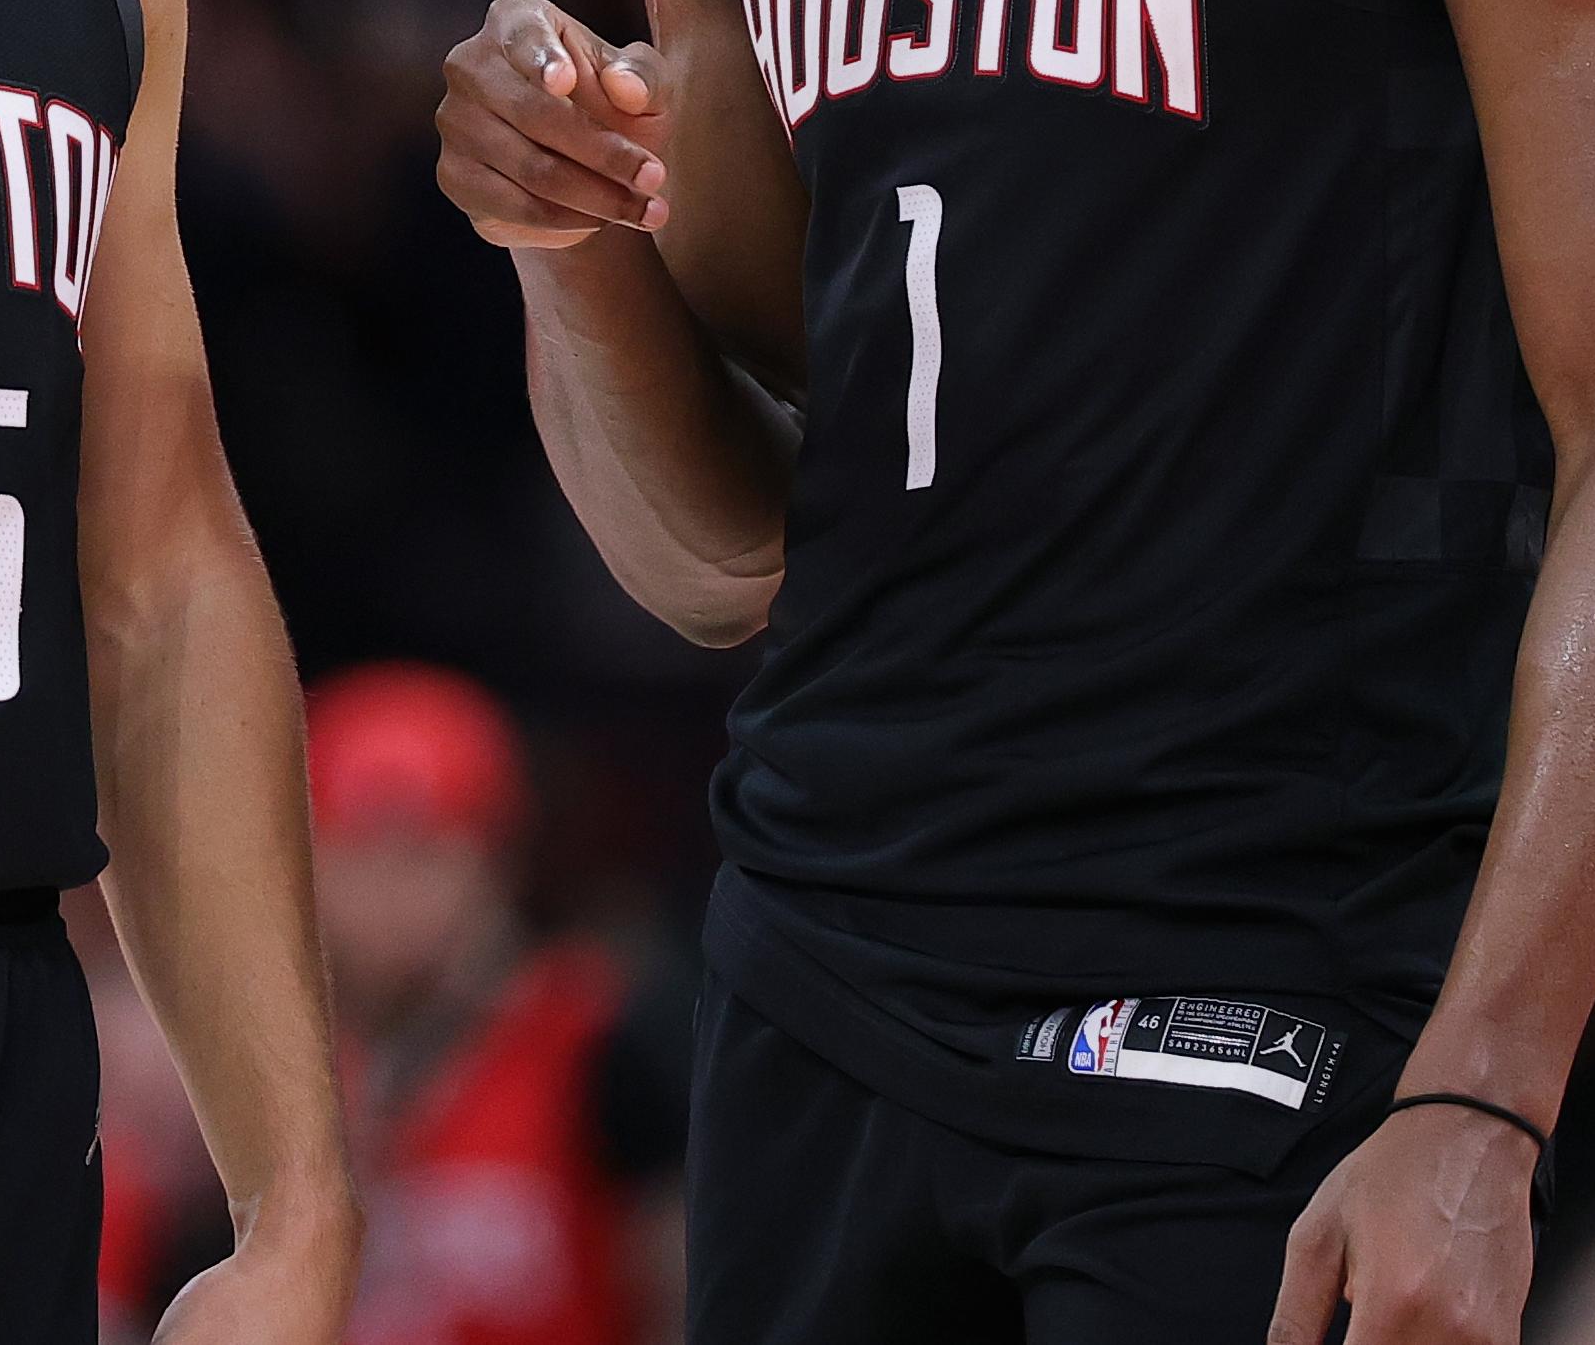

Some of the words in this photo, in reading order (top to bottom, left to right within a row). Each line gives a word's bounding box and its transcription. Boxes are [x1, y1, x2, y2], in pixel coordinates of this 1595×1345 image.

[896, 184, 943, 490] 1
[1178, 1002, 1261, 1020] ENGINEERED
[1138, 1014, 1161, 1030] 46
[1074, 1052, 1092, 1067] NBA
